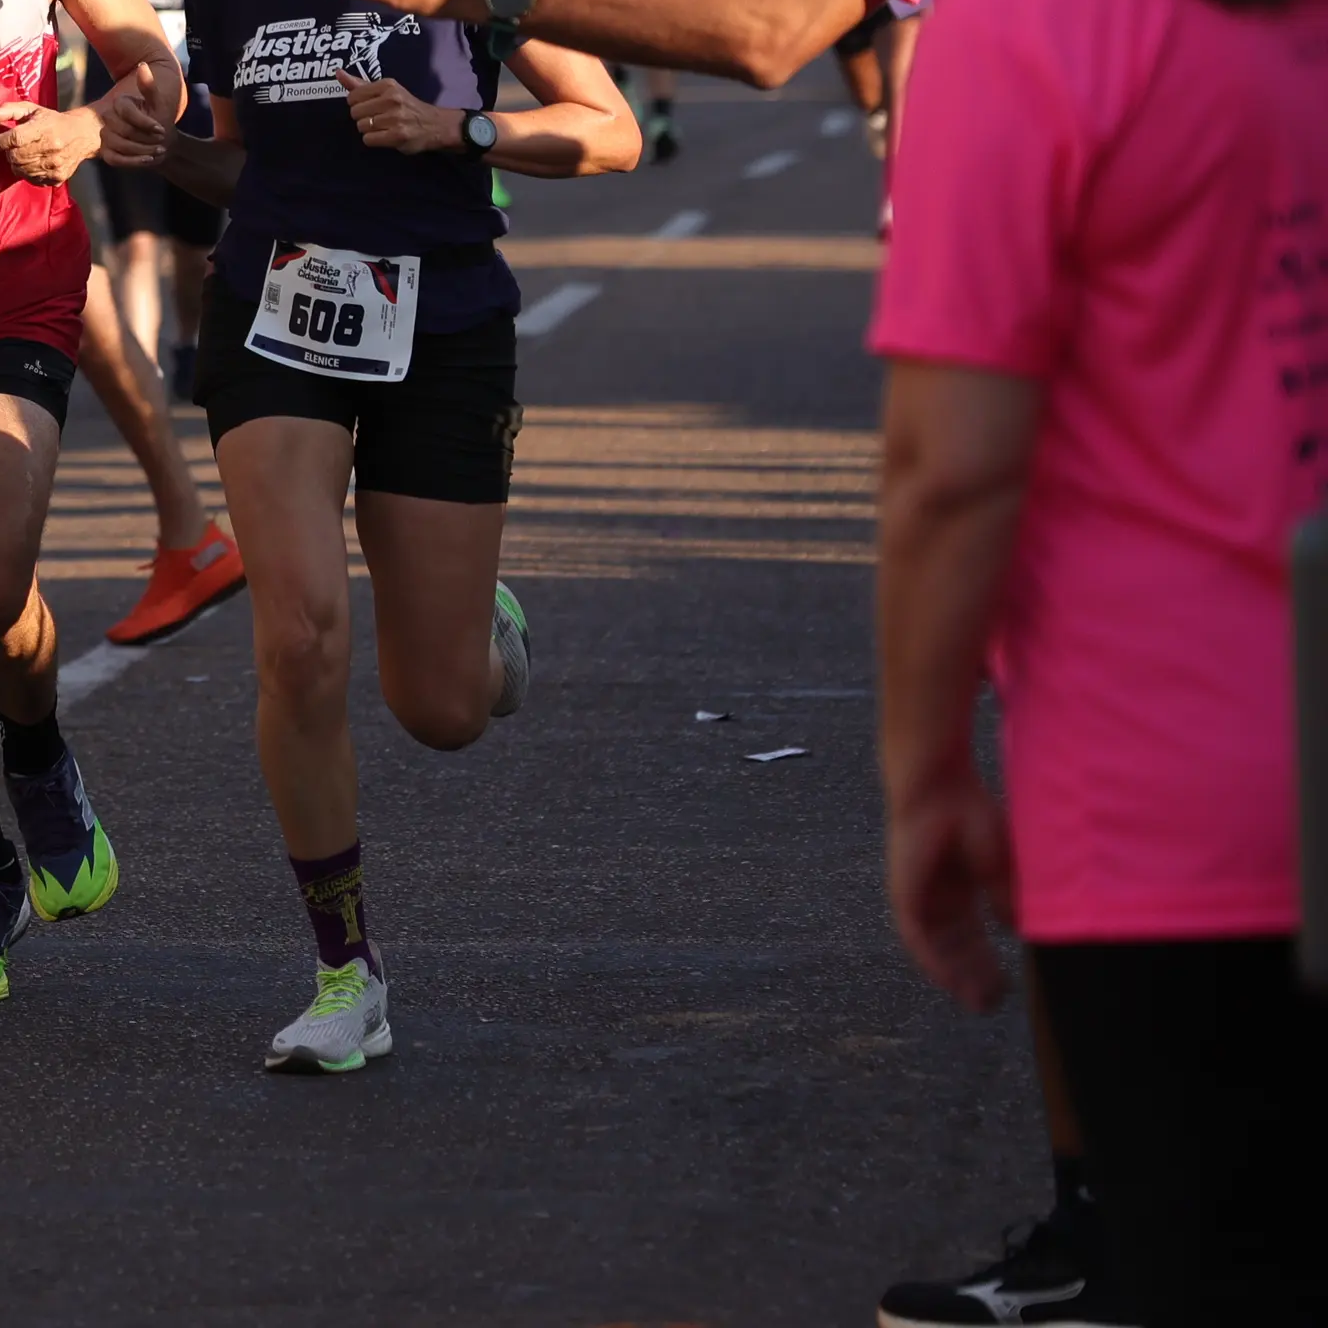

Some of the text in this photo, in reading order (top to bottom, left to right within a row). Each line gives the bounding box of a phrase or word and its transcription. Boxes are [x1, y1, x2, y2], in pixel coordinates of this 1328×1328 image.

[279, 21, 312, 30] CORRIDA
[320, 23, 332, 33] da
[242, 24, 352, 62] Justiça
[303, 257, 341, 277] Justiça
[297, 269, 339, 286] Cidadania
[289, 292, 365, 347] 608
[304, 352, 340, 368] ELENICE
